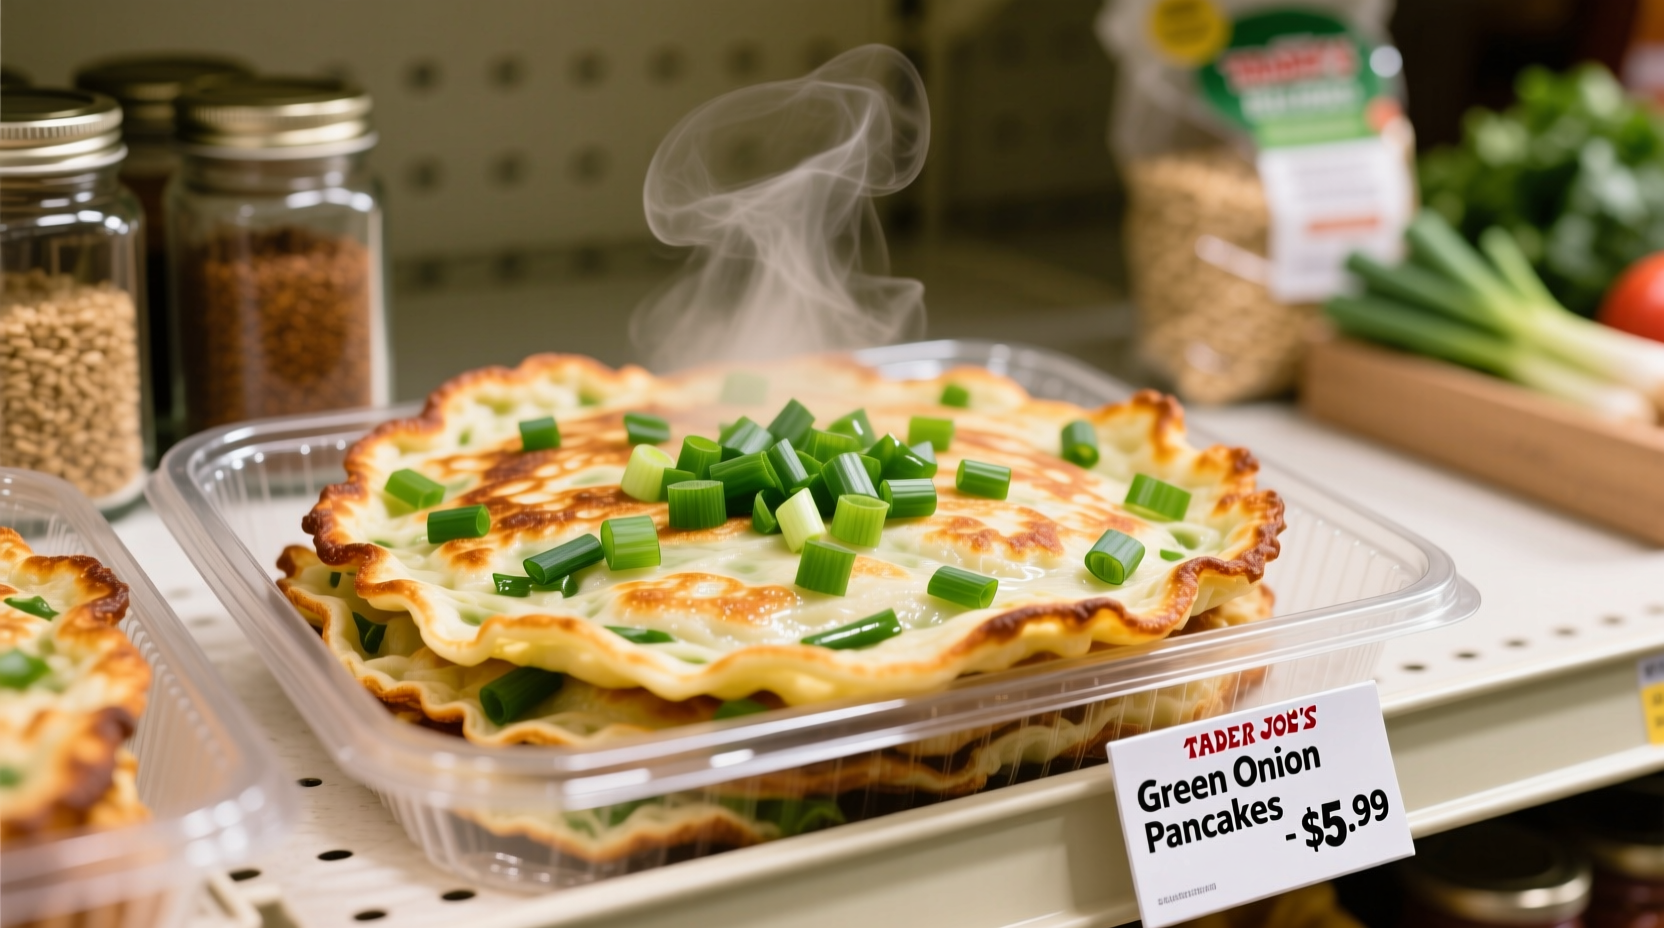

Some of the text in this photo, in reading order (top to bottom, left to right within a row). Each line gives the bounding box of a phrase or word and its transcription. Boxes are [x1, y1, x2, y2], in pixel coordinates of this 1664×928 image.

[1183, 704, 1317, 760] TADER JOE'S
[1137, 745, 1321, 813] Green Onion
[1144, 796, 1284, 854] Pancakes
[1301, 788, 1389, 853] $5.99
